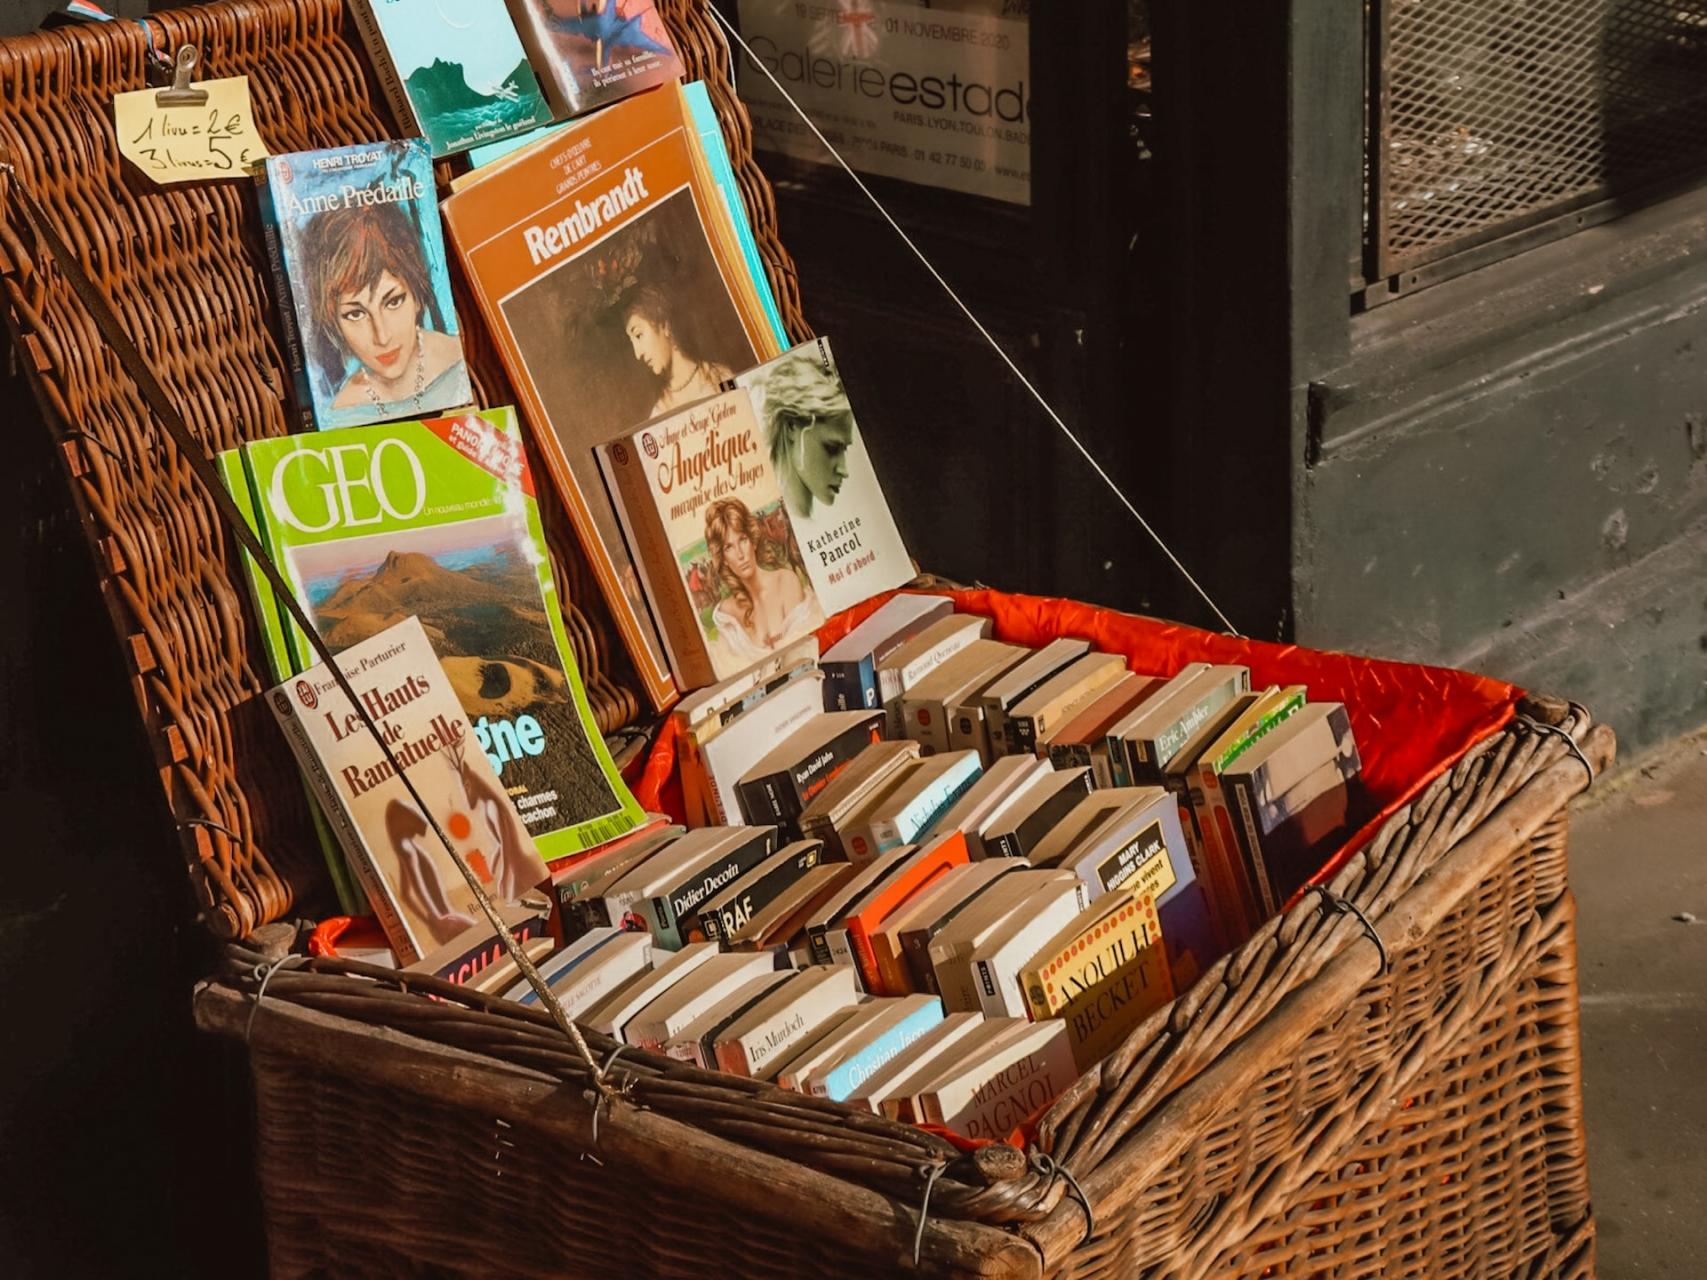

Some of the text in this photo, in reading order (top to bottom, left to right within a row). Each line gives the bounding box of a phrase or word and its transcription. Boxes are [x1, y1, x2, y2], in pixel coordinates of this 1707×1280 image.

[903, 21, 978, 47] NOVEMBRE
[313, 154, 345, 170] HENRI
[345, 151, 384, 167] TROYAT
[287, 173, 426, 218] Anne Prédaille
[523, 165, 650, 266] Rembrandt
[657, 428, 758, 495] Angélique,
[271, 437, 428, 534] GEO
[806, 516, 862, 554] Katherine
[819, 535, 862, 568] Pancol
[359, 640, 408, 672] Parturier
[358, 674, 432, 722] Hauts
[381, 719, 406, 747] de
[1158, 730, 1180, 751] Eric
[517, 789, 558, 810] charmes
[1106, 864, 1141, 892] HIGGINS
[1137, 841, 1161, 869] CLARK
[1118, 842, 1141, 866] MARY
[674, 862, 740, 918] Didier Decoin
[1141, 861, 1165, 889] vivent
[1073, 960, 1150, 1042] BECKET
[749, 1039, 767, 1065] Iris
[970, 1055, 1041, 1109] MARCEL
